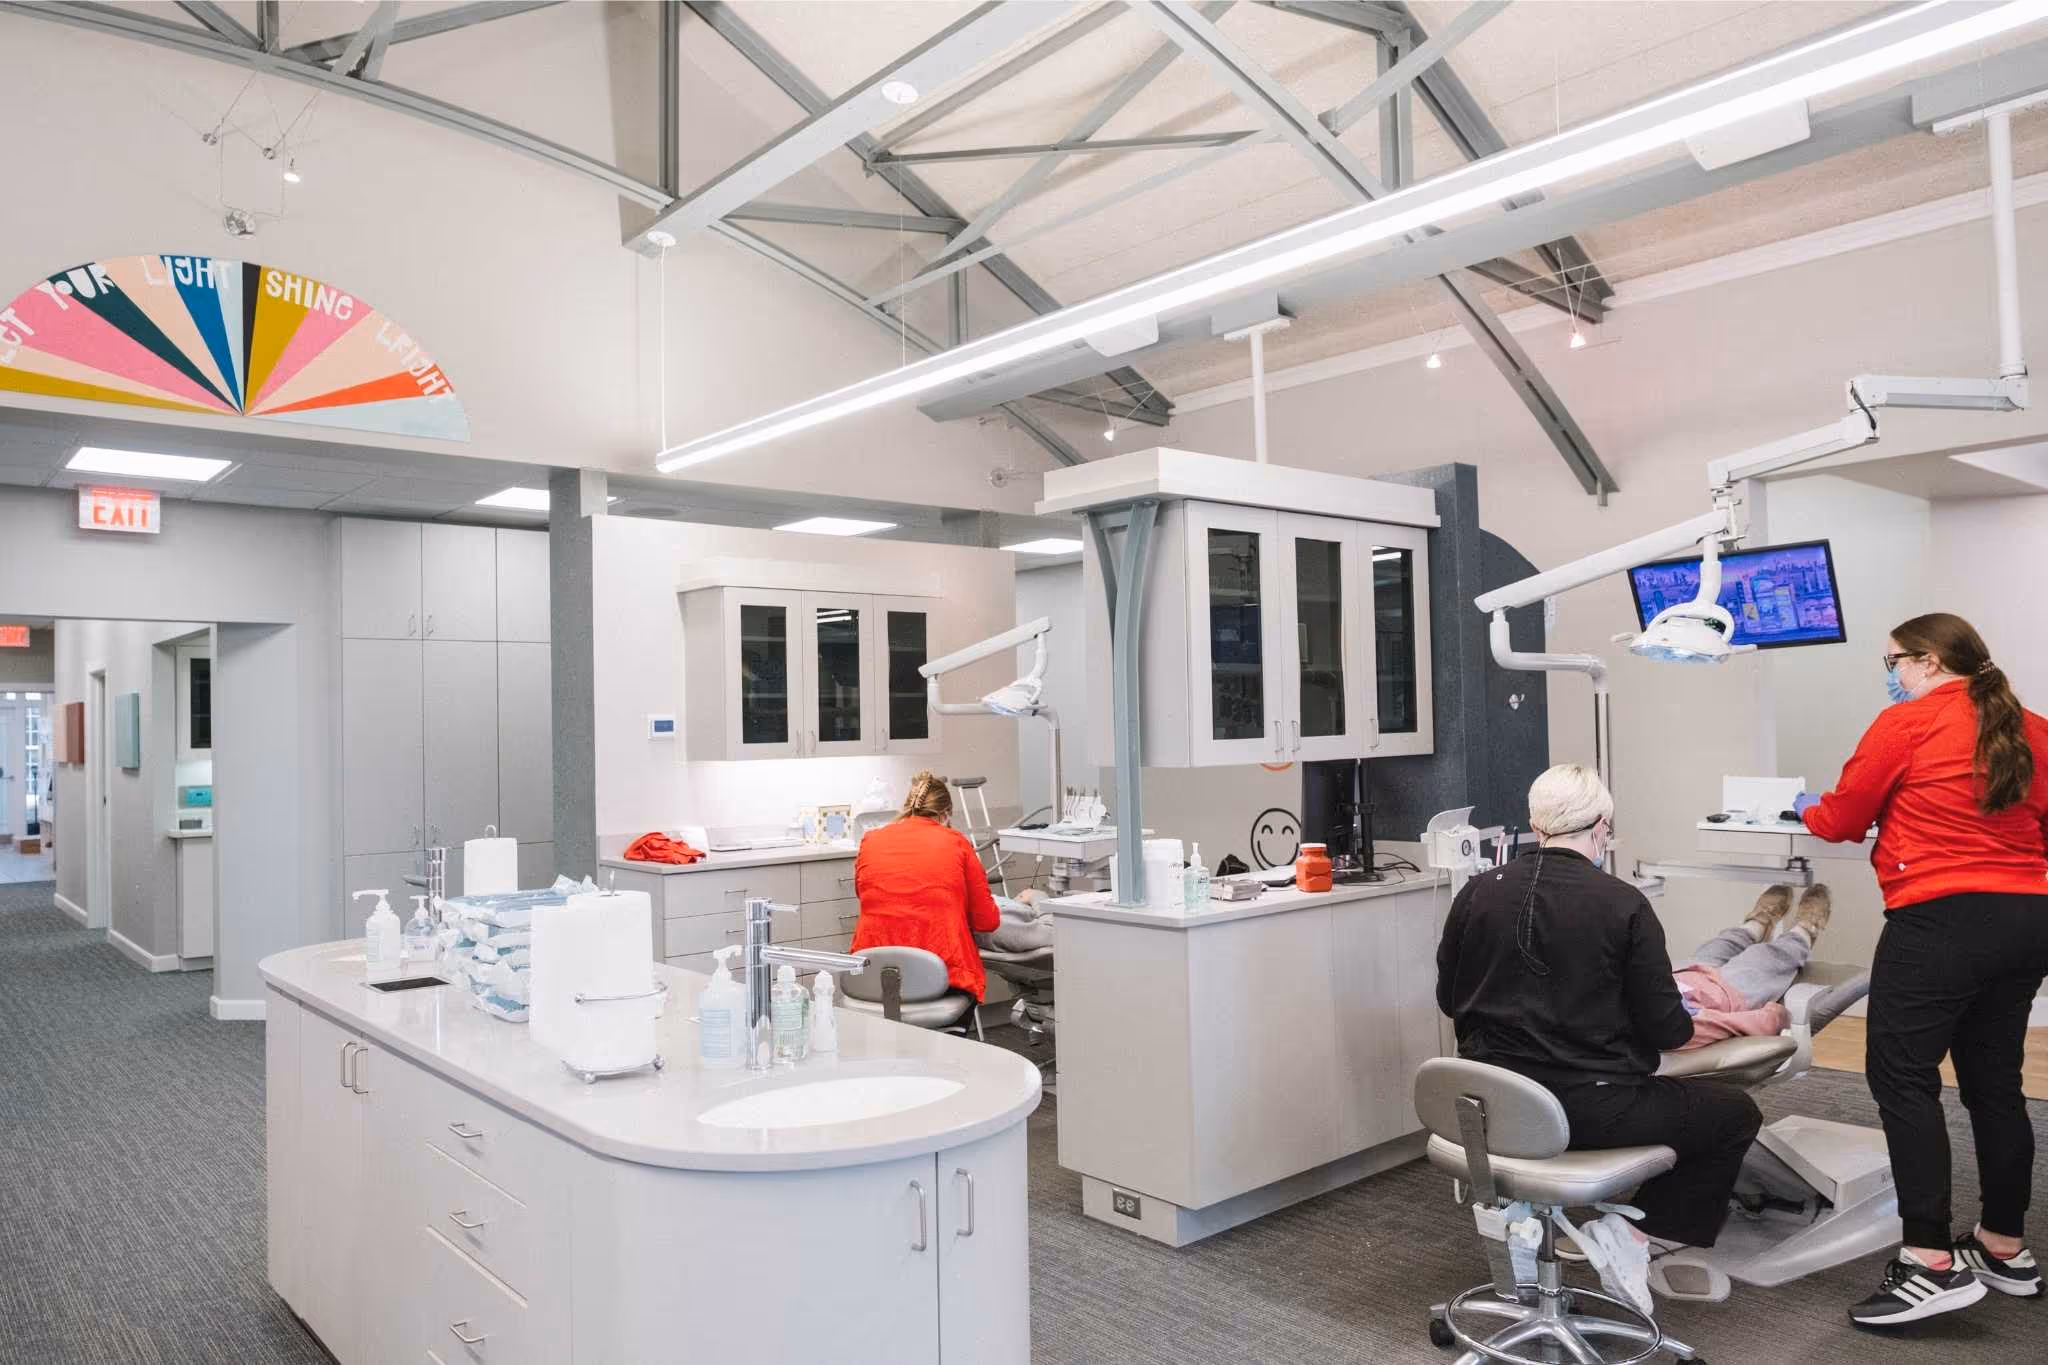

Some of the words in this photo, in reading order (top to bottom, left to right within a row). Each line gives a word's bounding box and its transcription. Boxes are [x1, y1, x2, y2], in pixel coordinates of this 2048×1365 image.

[32, 263, 116, 312] YOUR
[141, 256, 233, 289] LIGHT
[265, 270, 354, 321] SHINE
[92, 490, 153, 528] EXIT
